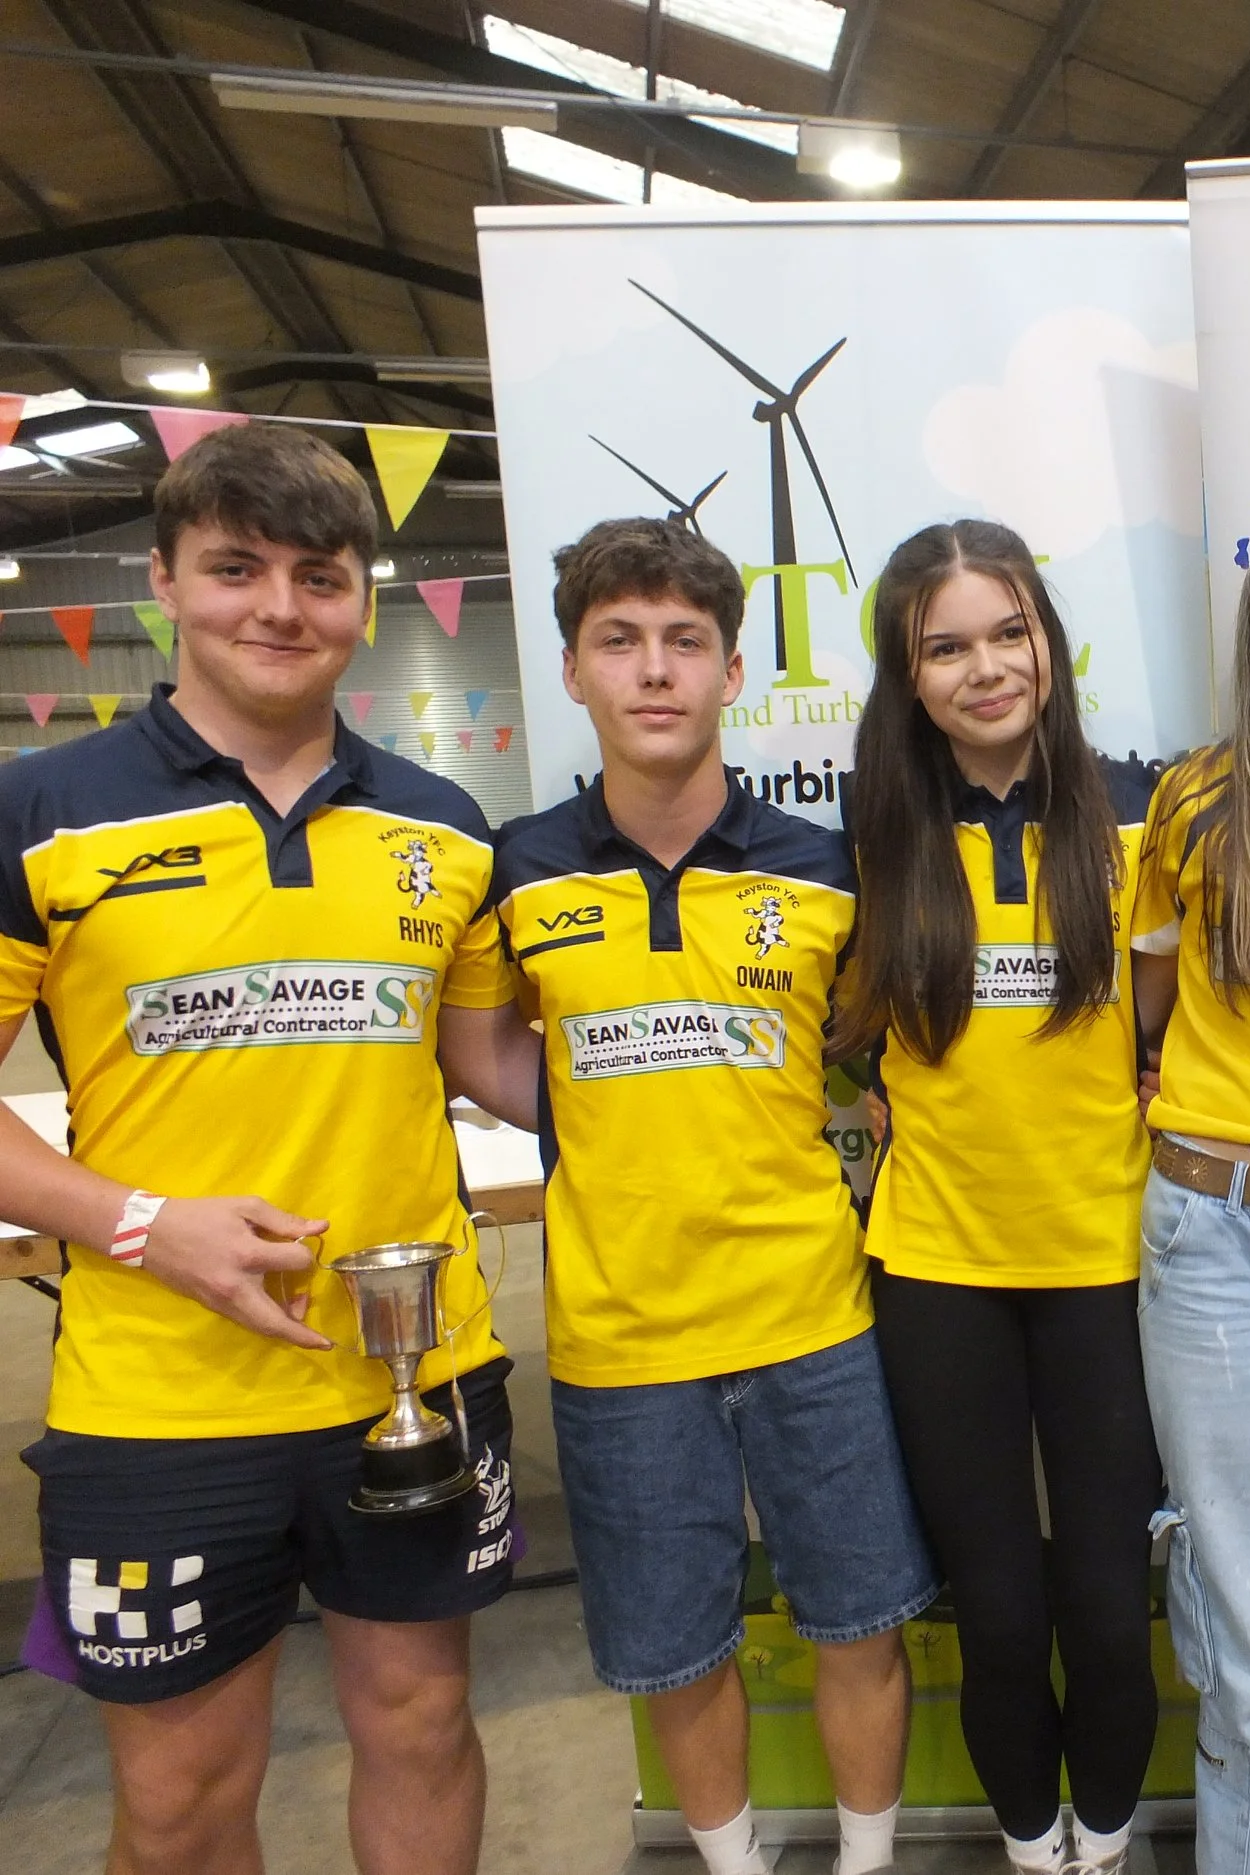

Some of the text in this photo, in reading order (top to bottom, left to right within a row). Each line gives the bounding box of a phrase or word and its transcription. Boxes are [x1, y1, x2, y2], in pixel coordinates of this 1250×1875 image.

[720, 691, 864, 729] ind Turb
[378, 826, 425, 844] Keyston
[96, 845, 203, 879] VX3
[736, 882, 801, 910] Keyston YFC
[399, 915, 444, 949] RHYS
[536, 905, 604, 932] VX3
[736, 965, 793, 993] OWAIN
[991, 987, 1056, 999] Contract
[141, 970, 365, 1020] SEAN SAVAGE
[145, 1017, 368, 1048] Agricultural Contractor
[573, 1018, 630, 1049] SEAN
[575, 1045, 729, 1074] Agricultural Contractor
[78, 1633, 208, 1668] HOSTPLUS
